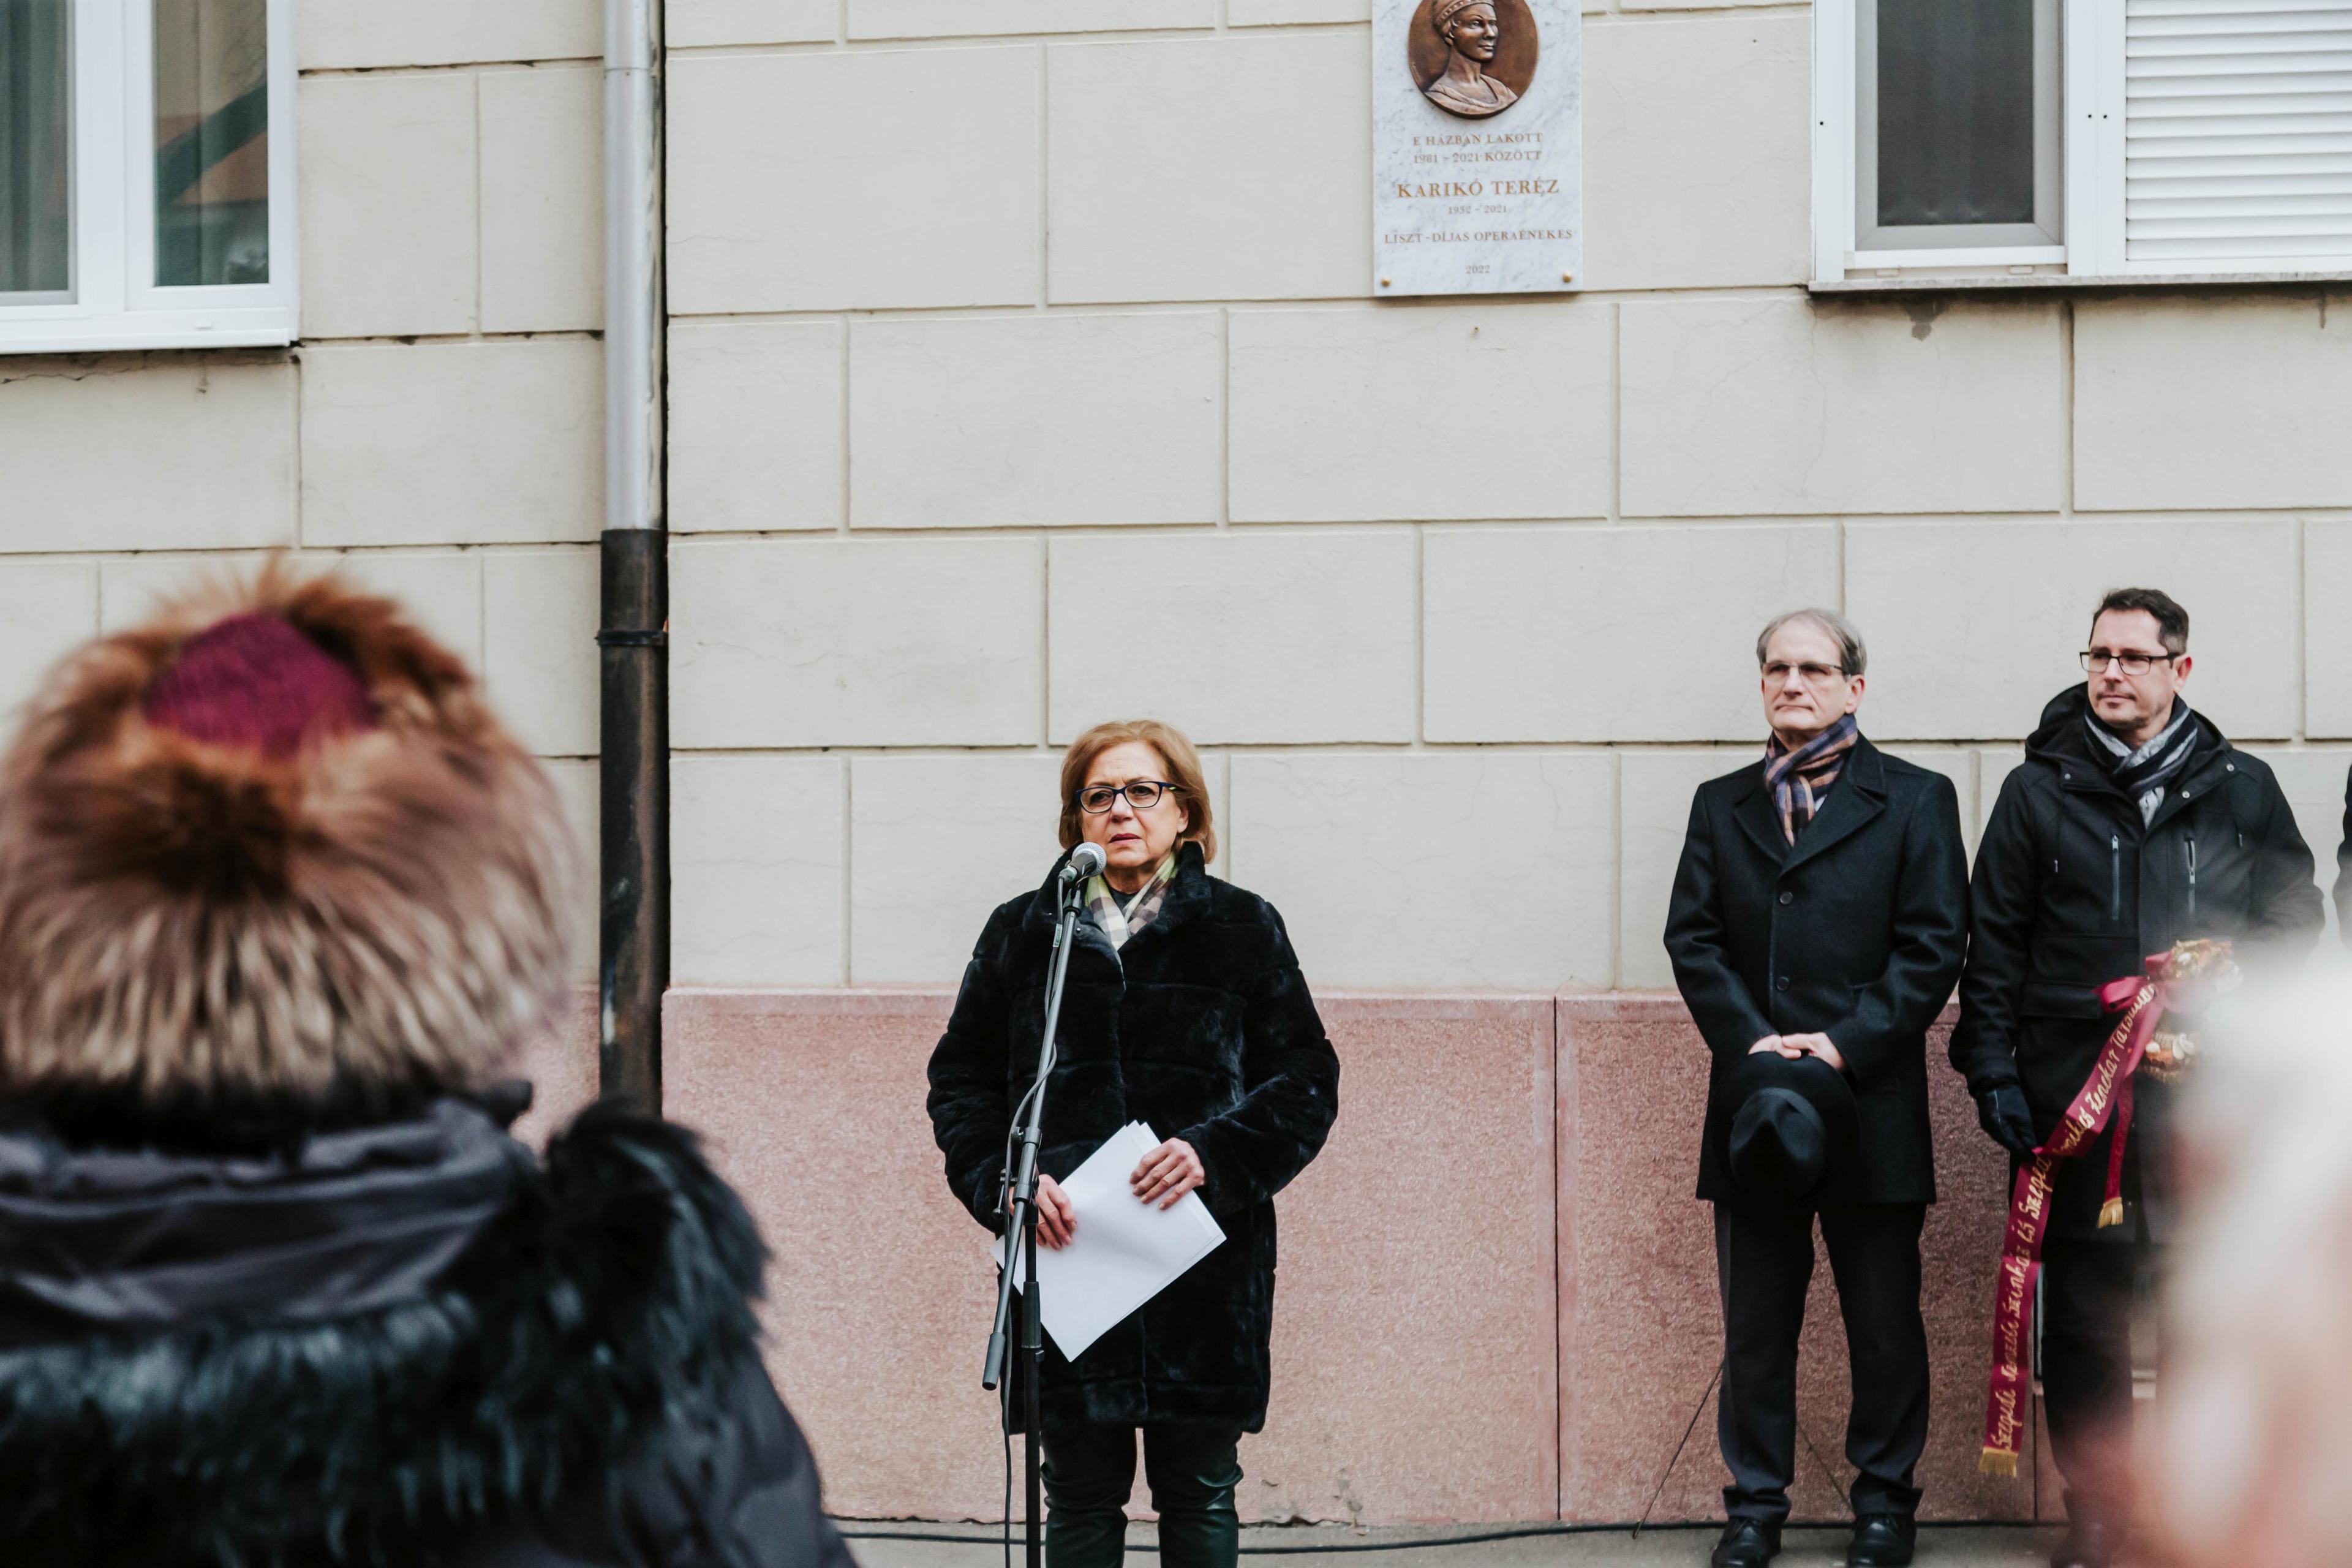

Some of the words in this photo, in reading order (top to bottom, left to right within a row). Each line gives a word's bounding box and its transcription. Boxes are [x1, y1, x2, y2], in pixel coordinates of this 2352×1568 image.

[1412, 136, 1420, 146] E
[1487, 132, 1543, 143] LAKOTT
[1414, 154, 1438, 164] 1981
[1452, 152, 1480, 162] 2021
[1485, 149, 1542, 161] KÖZÖTT
[1396, 178, 1483, 198] KARIKÓ
[1491, 176, 1559, 195] TERÉZ
[1483, 205, 1507, 214] 2021
[1474, 229, 1573, 241] OPERAÉNEKES
[1466, 264, 1490, 274] 2022
